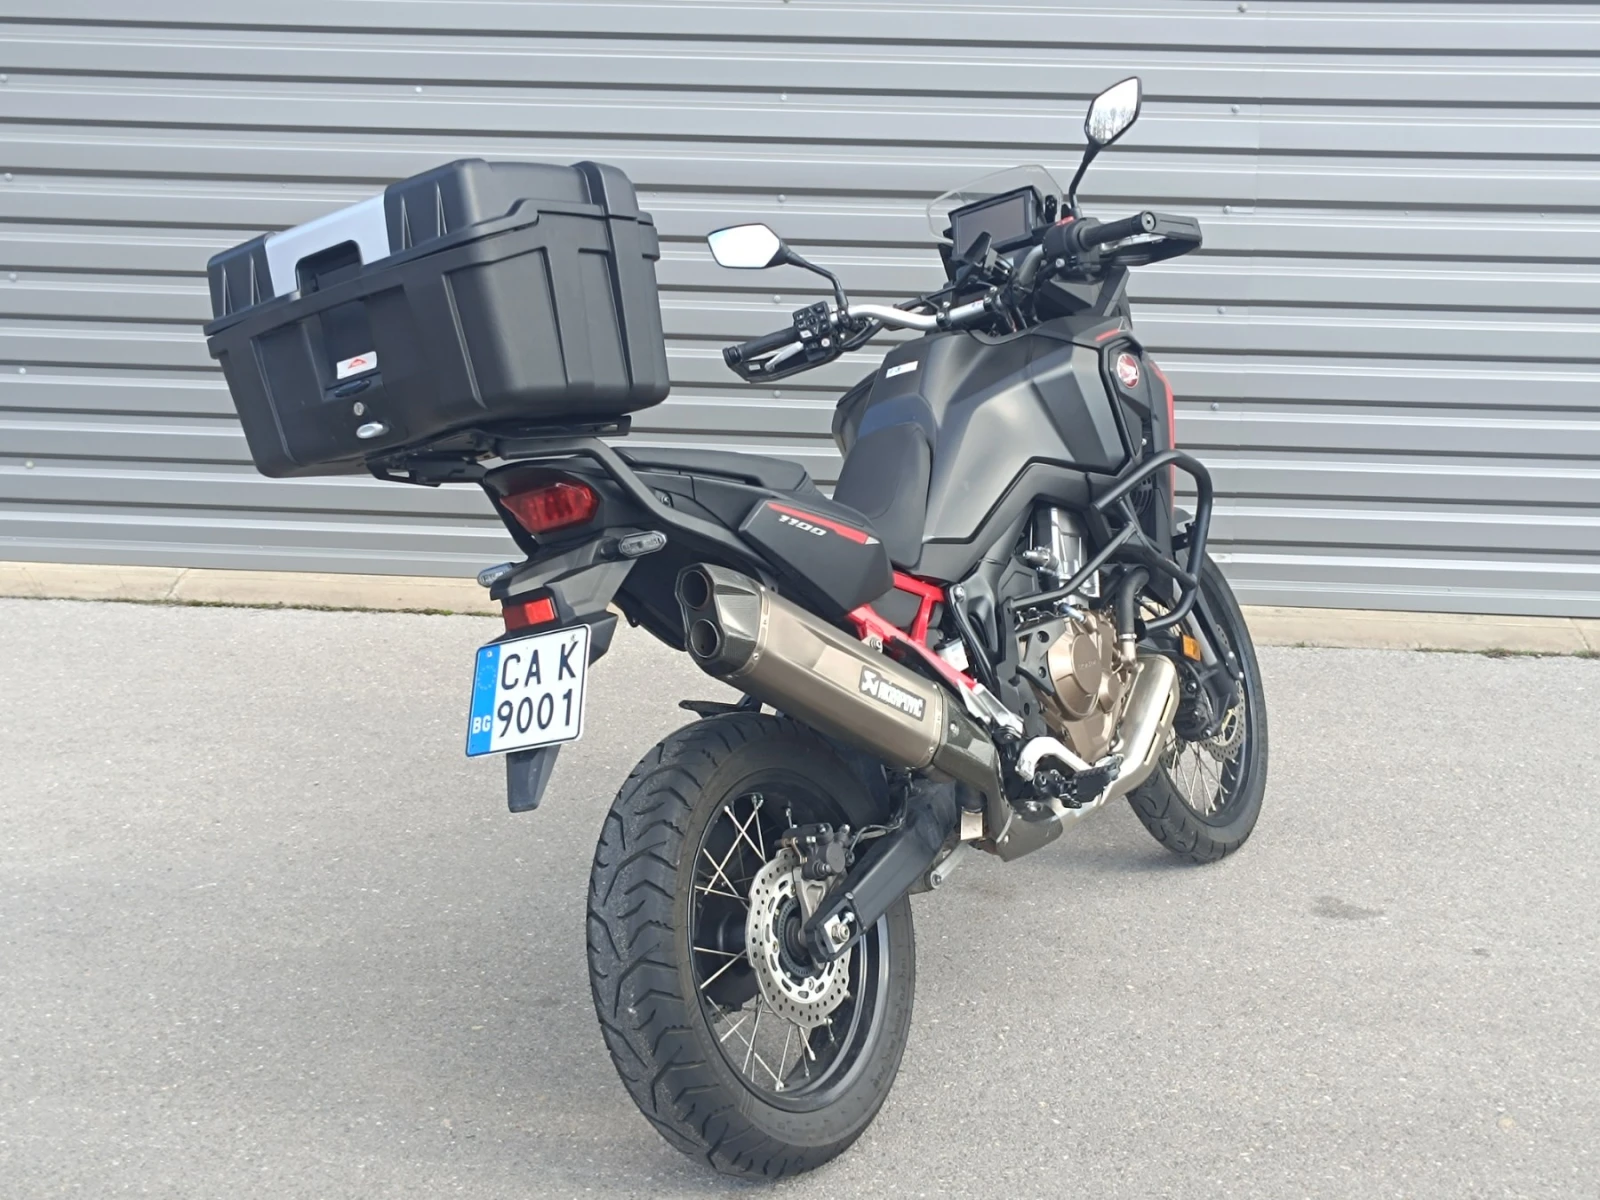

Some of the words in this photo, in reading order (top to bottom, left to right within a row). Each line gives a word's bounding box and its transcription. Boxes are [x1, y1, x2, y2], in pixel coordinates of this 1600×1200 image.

[778, 514, 827, 536] 1100
[501, 649, 542, 690] CA
[558, 641, 579, 681] K
[472, 714, 492, 734] BG
[497, 688, 573, 738] 9001
